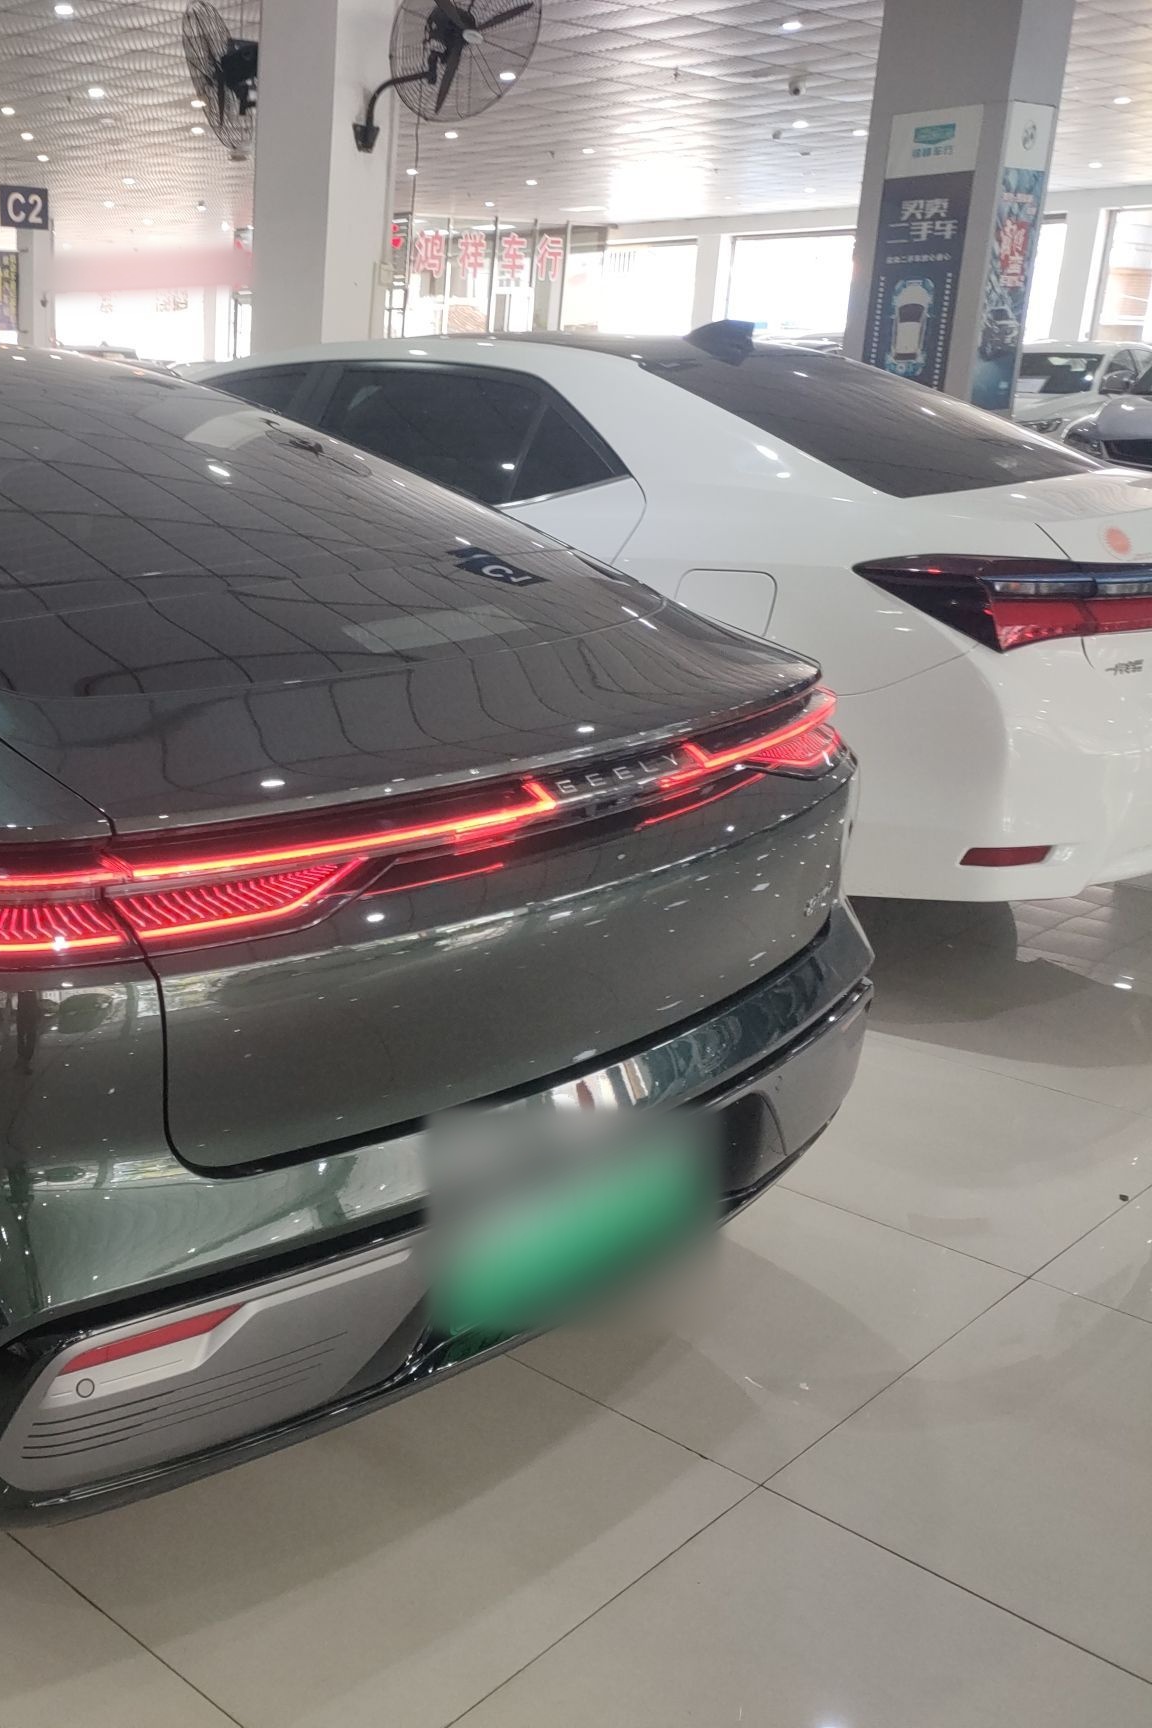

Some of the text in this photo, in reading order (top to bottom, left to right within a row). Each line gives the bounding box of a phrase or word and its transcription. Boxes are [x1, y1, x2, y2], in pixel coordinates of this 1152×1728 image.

[7, 191, 43, 225] C2
[901, 198, 949, 221] 买卖
[886, 219, 958, 243] 二手车
[413, 229, 564, 281] 鸿祥车行
[556, 753, 678, 794] GEELY
